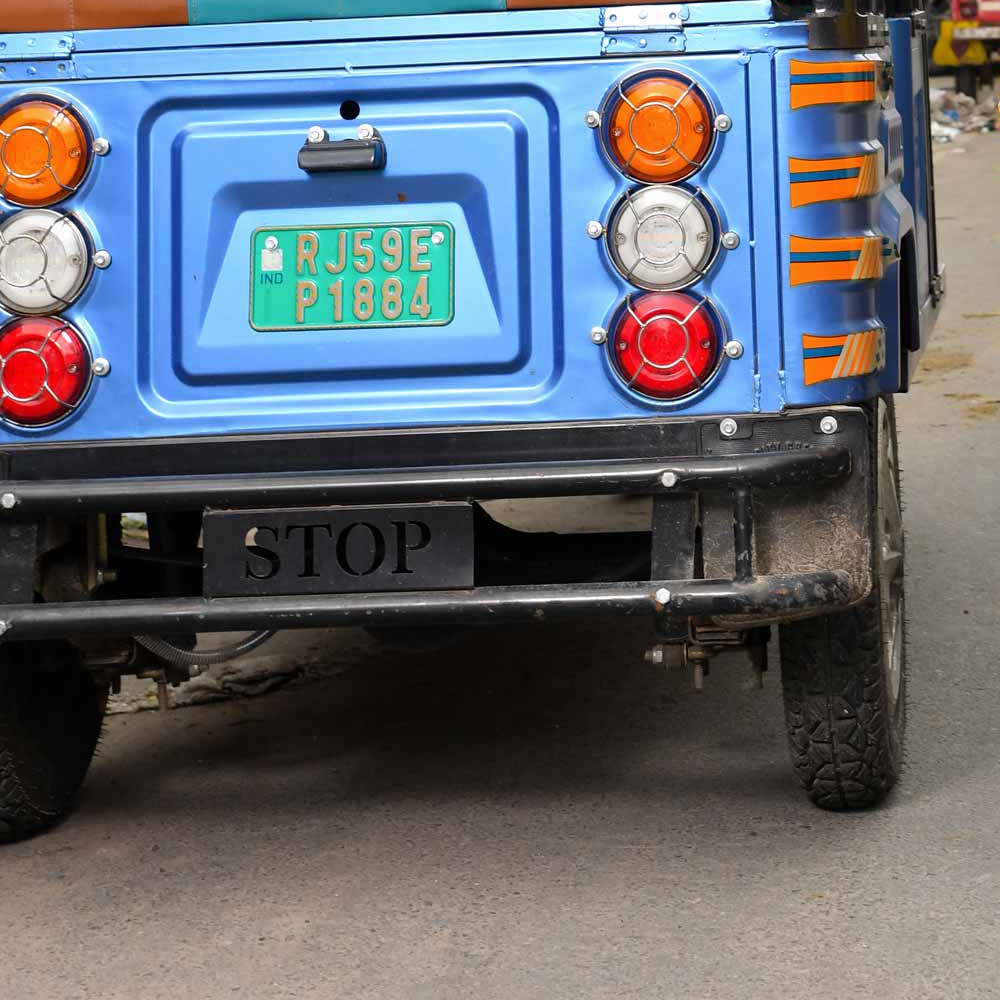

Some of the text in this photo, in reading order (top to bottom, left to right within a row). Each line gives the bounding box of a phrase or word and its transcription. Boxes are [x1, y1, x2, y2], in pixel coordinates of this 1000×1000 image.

[296, 227, 433, 276] RJ59E
[260, 272, 284, 285] IND
[296, 275, 432, 324] P1884
[244, 520, 432, 580] STOP
